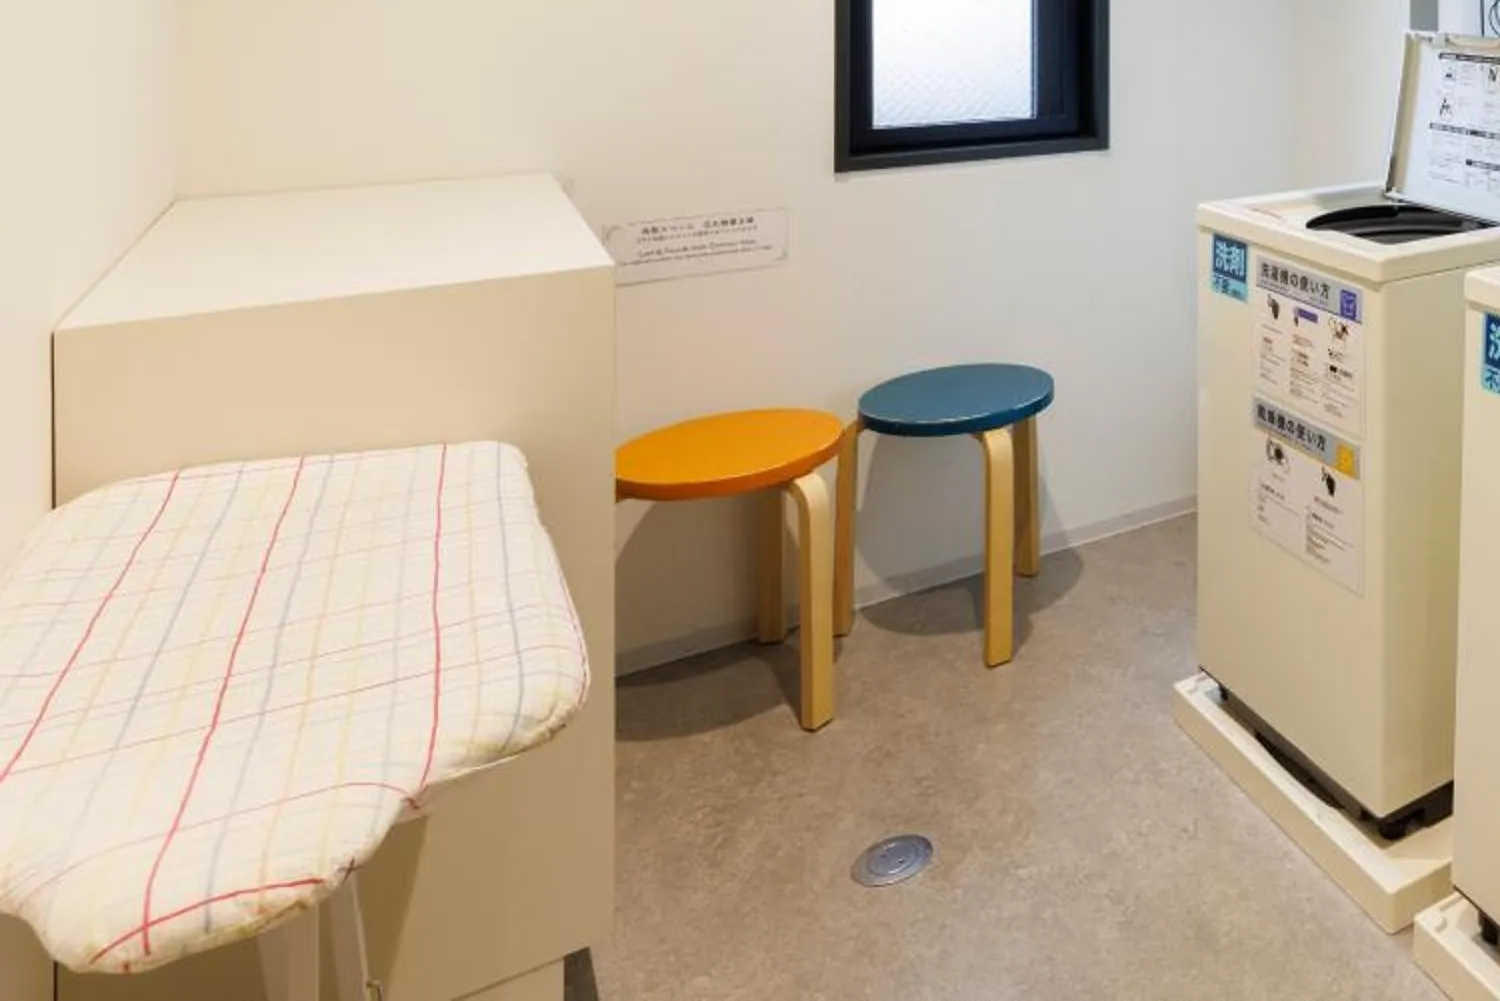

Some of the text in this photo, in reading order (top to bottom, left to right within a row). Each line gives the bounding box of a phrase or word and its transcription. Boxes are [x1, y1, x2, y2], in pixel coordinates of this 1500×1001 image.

[1261, 262, 1331, 300] 洗濯機の使い方
